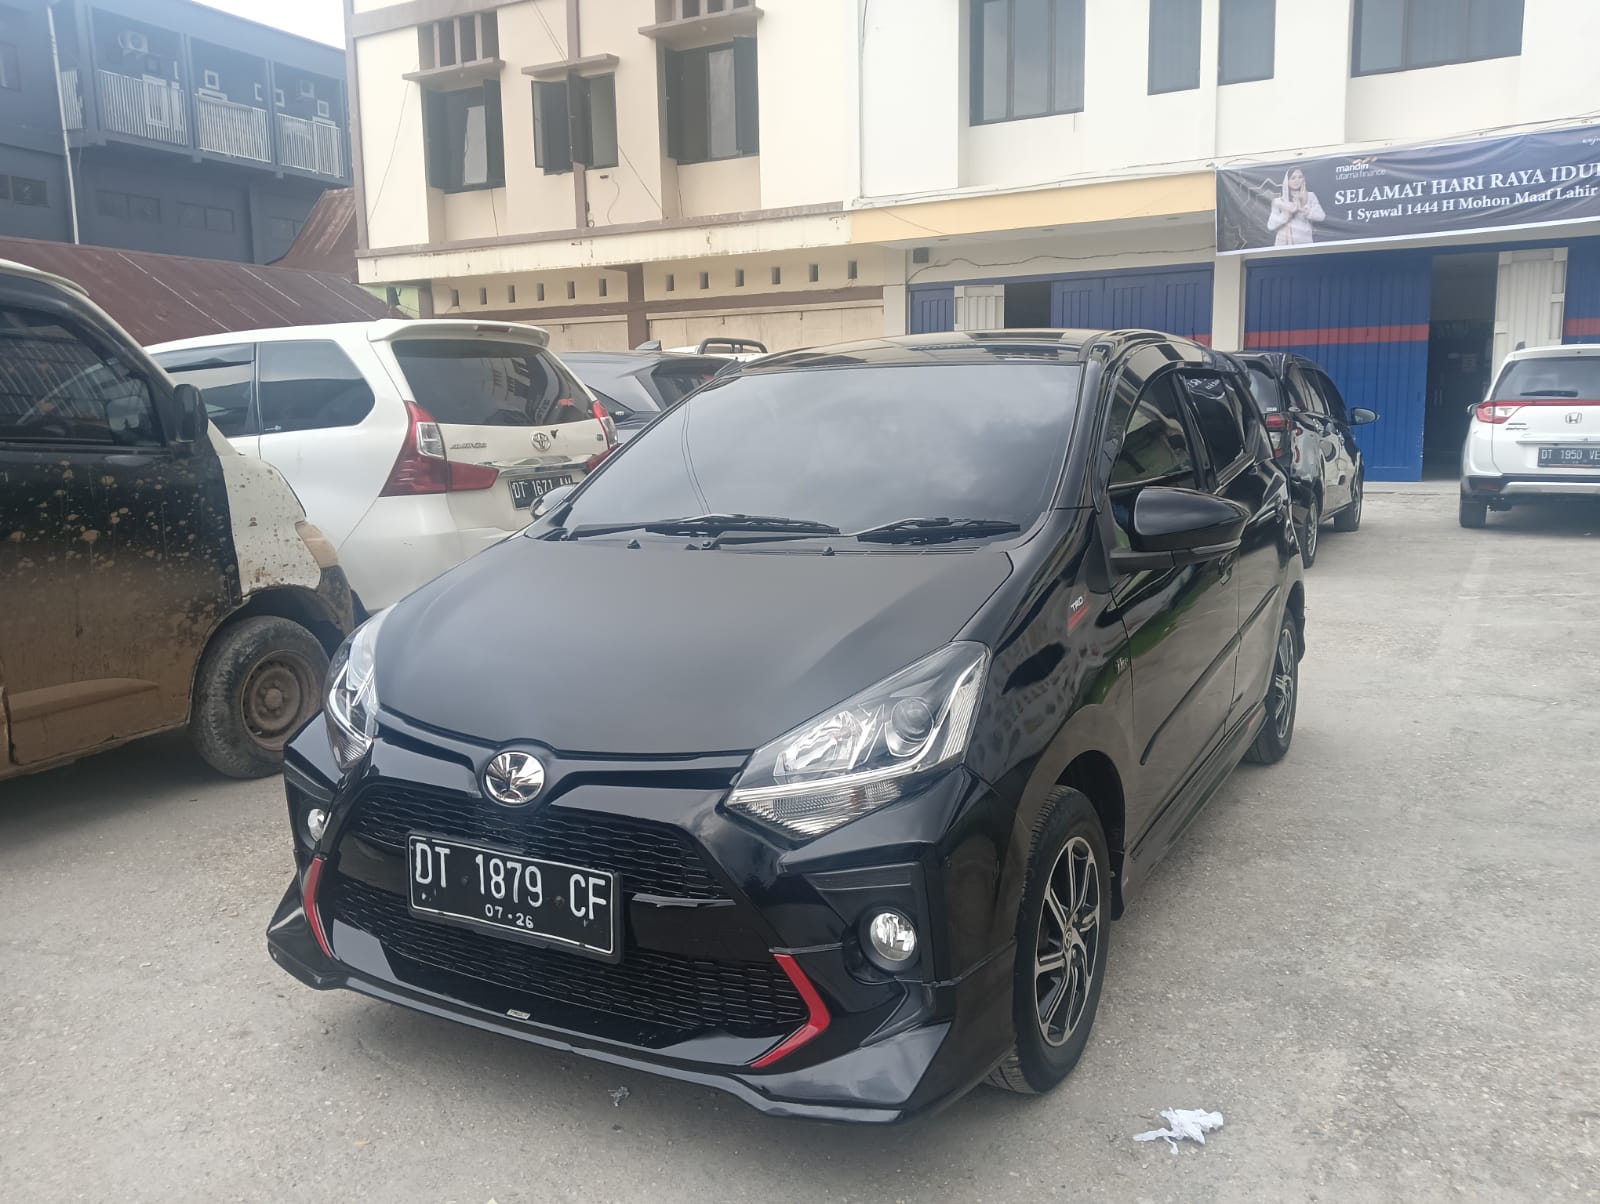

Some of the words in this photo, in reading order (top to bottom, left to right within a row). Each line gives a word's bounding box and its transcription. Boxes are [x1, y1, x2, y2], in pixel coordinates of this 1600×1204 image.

[1334, 181, 1427, 205] SELAMAT
[1431, 174, 1486, 195] HARI
[1489, 168, 1546, 189] RAYA
[1347, 210, 1353, 221] 1
[1357, 204, 1402, 222] Syawal
[1406, 200, 1439, 215] 1444
[1442, 198, 1455, 211] H
[1458, 195, 1510, 210] Mohon
[1514, 188, 1555, 204] Maaf
[1555, 184, 1598, 200] Lahir
[1541, 449, 1553, 460] DT
[1560, 449, 1583, 460] 1950
[511, 481, 526, 499] DT
[531, 479, 553, 497] 1671
[1070, 596, 1084, 612] TRD
[414, 842, 451, 888] DT
[475, 854, 543, 907] 1879
[569, 873, 607, 920] CF
